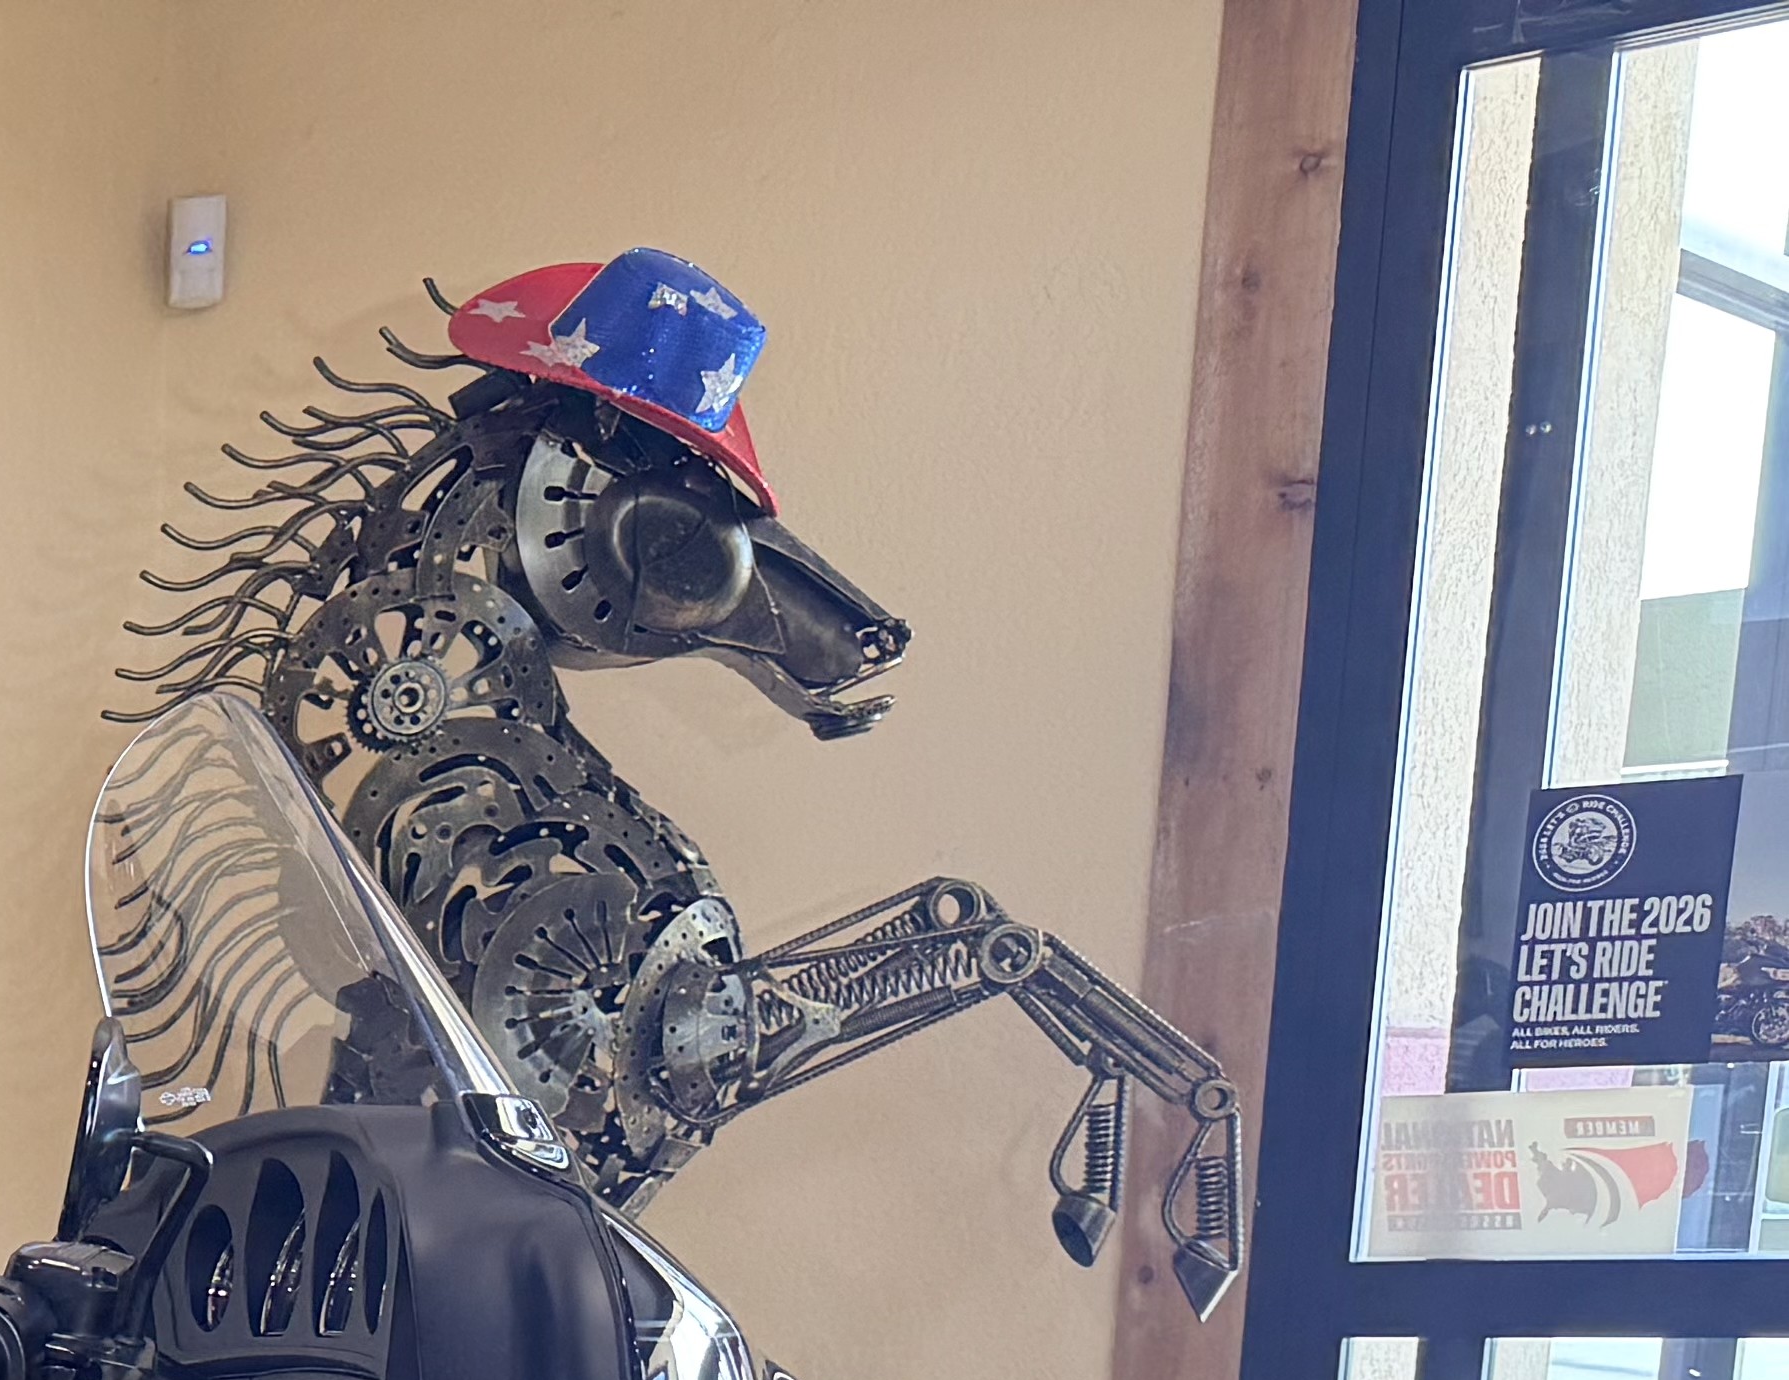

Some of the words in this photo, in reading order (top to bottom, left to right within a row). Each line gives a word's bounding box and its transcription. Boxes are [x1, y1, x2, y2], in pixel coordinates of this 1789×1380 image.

[1520, 901, 1584, 941] JOIN
[1587, 898, 1640, 938] THE
[1640, 893, 1713, 935] 2026
[1517, 941, 1589, 982] LET'S
[1592, 938, 1657, 979] RIDE
[1510, 1040, 1532, 1050] ALL
[1534, 1039, 1557, 1049] FOR
[1512, 1027, 1533, 1038] ALL
[1572, 1025, 1593, 1035] ALL
